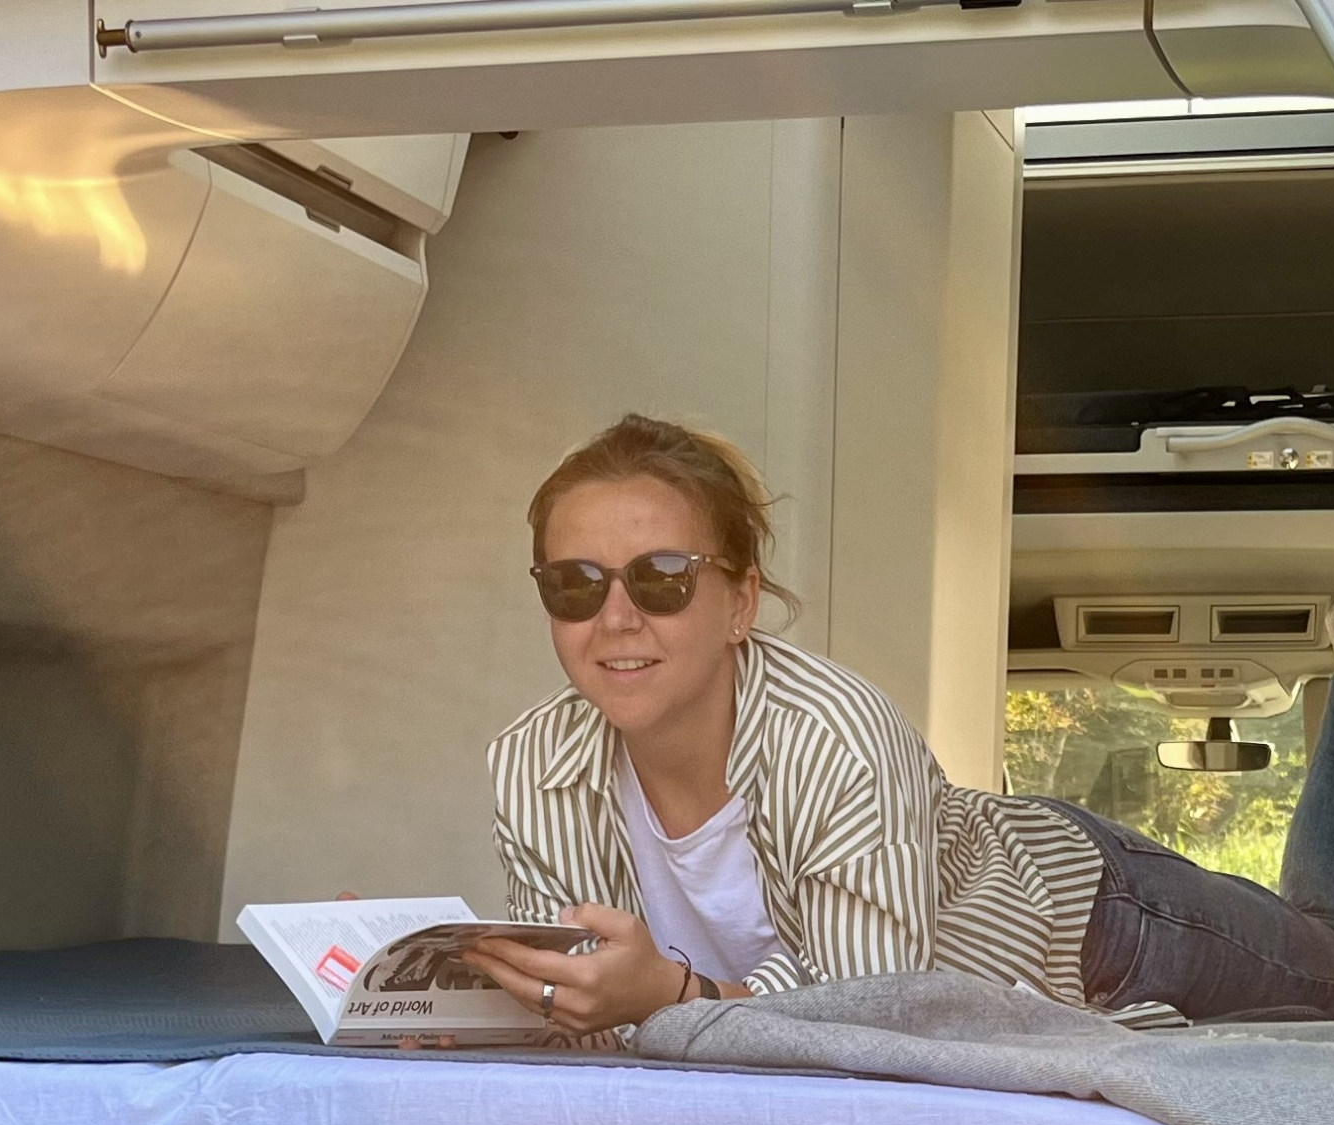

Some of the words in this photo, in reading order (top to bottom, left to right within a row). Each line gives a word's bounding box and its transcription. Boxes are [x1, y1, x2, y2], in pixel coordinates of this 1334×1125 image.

[348, 1002, 369, 1016] Art
[372, 1001, 390, 1016] of
[391, 1001, 434, 1016] World
